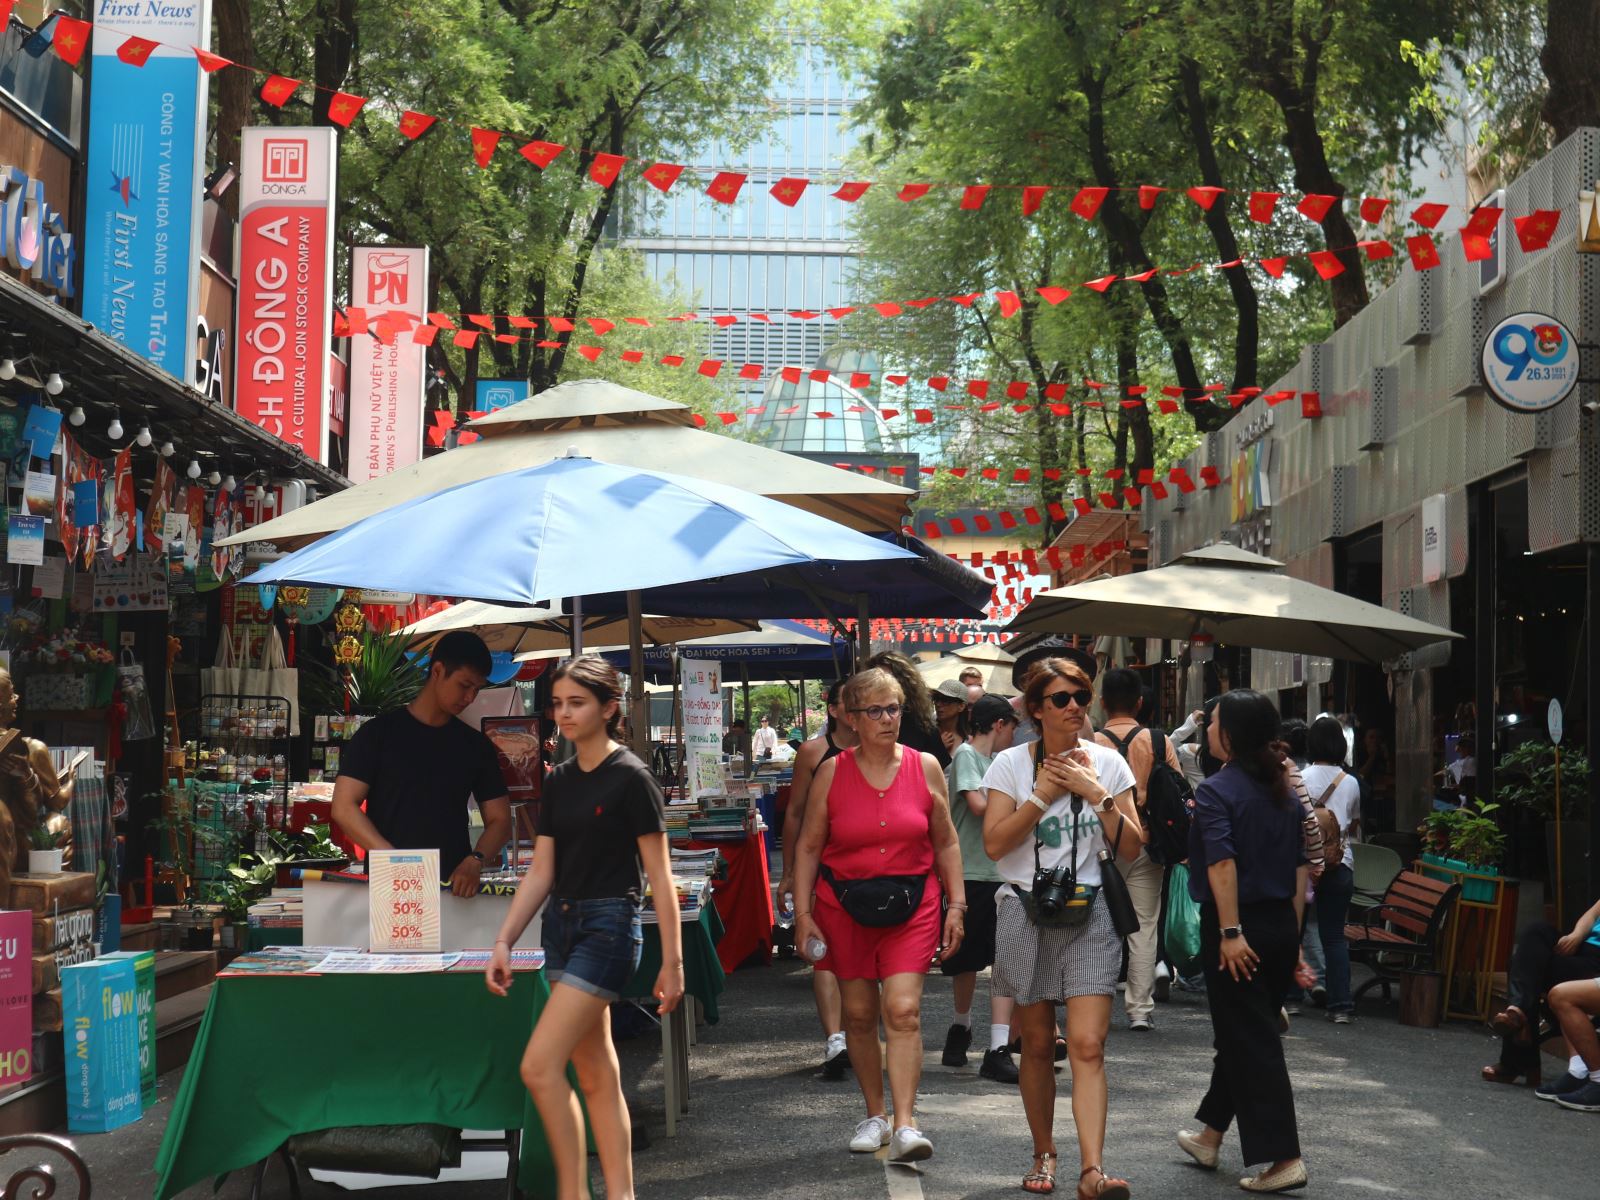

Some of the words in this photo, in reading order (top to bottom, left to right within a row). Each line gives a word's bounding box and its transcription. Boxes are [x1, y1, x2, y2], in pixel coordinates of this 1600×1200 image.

[99, 0, 141, 17] First
[145, 0, 193, 19] News
[158, 139, 172, 159] TY
[113, 210, 138, 270] First
[257, 216, 289, 246] A
[297, 216, 311, 284] COMPANY
[110, 275, 136, 341] News
[245, 257, 288, 385] ĐÔNG
[296, 286, 309, 328] STOCK
[295, 332, 307, 362] JOIN
[371, 336, 383, 360] NA
[1526, 367, 1550, 380] 26.3
[293, 363, 306, 427] CULTURAL
[644, 647, 684, 660] TRƯỜG
[705, 649, 726, 659] HỌC
[727, 648, 750, 657] HOA
[751, 647, 771, 656] SEN
[778, 647, 799, 655] HSU
[392, 879, 422, 892] 50%
[393, 902, 423, 915] 50%
[391, 926, 422, 938] 50%
[75, 1016, 91, 1060] flow
